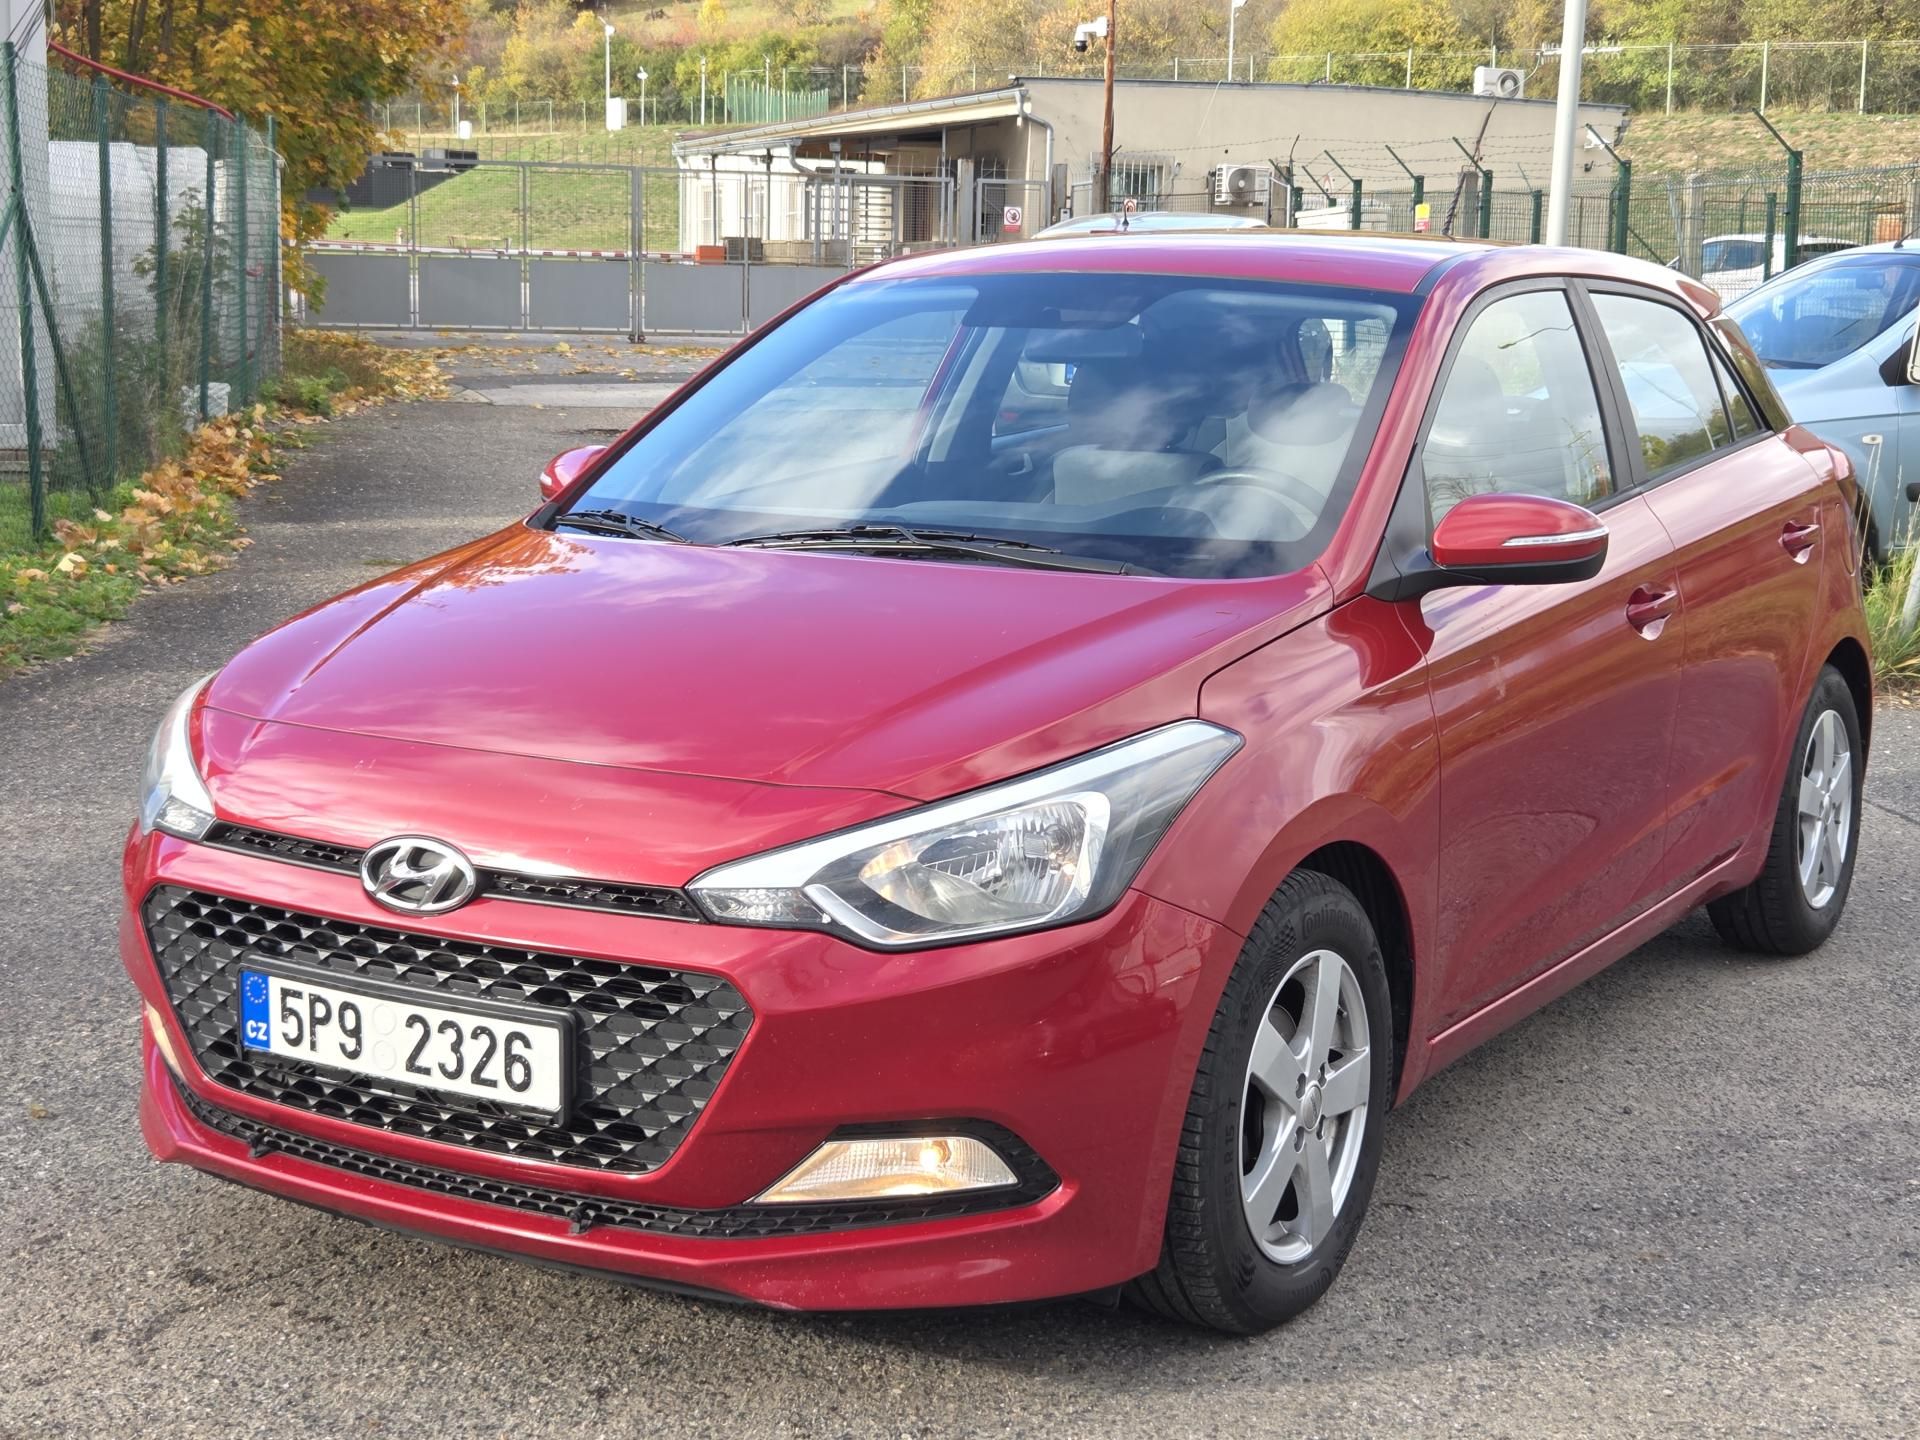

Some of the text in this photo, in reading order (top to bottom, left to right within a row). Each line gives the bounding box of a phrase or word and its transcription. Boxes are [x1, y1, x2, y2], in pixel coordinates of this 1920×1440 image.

[246, 1019, 268, 1041] CZ
[280, 986, 534, 1093] 5P9 2326
[1225, 1124, 1235, 1145] 15
